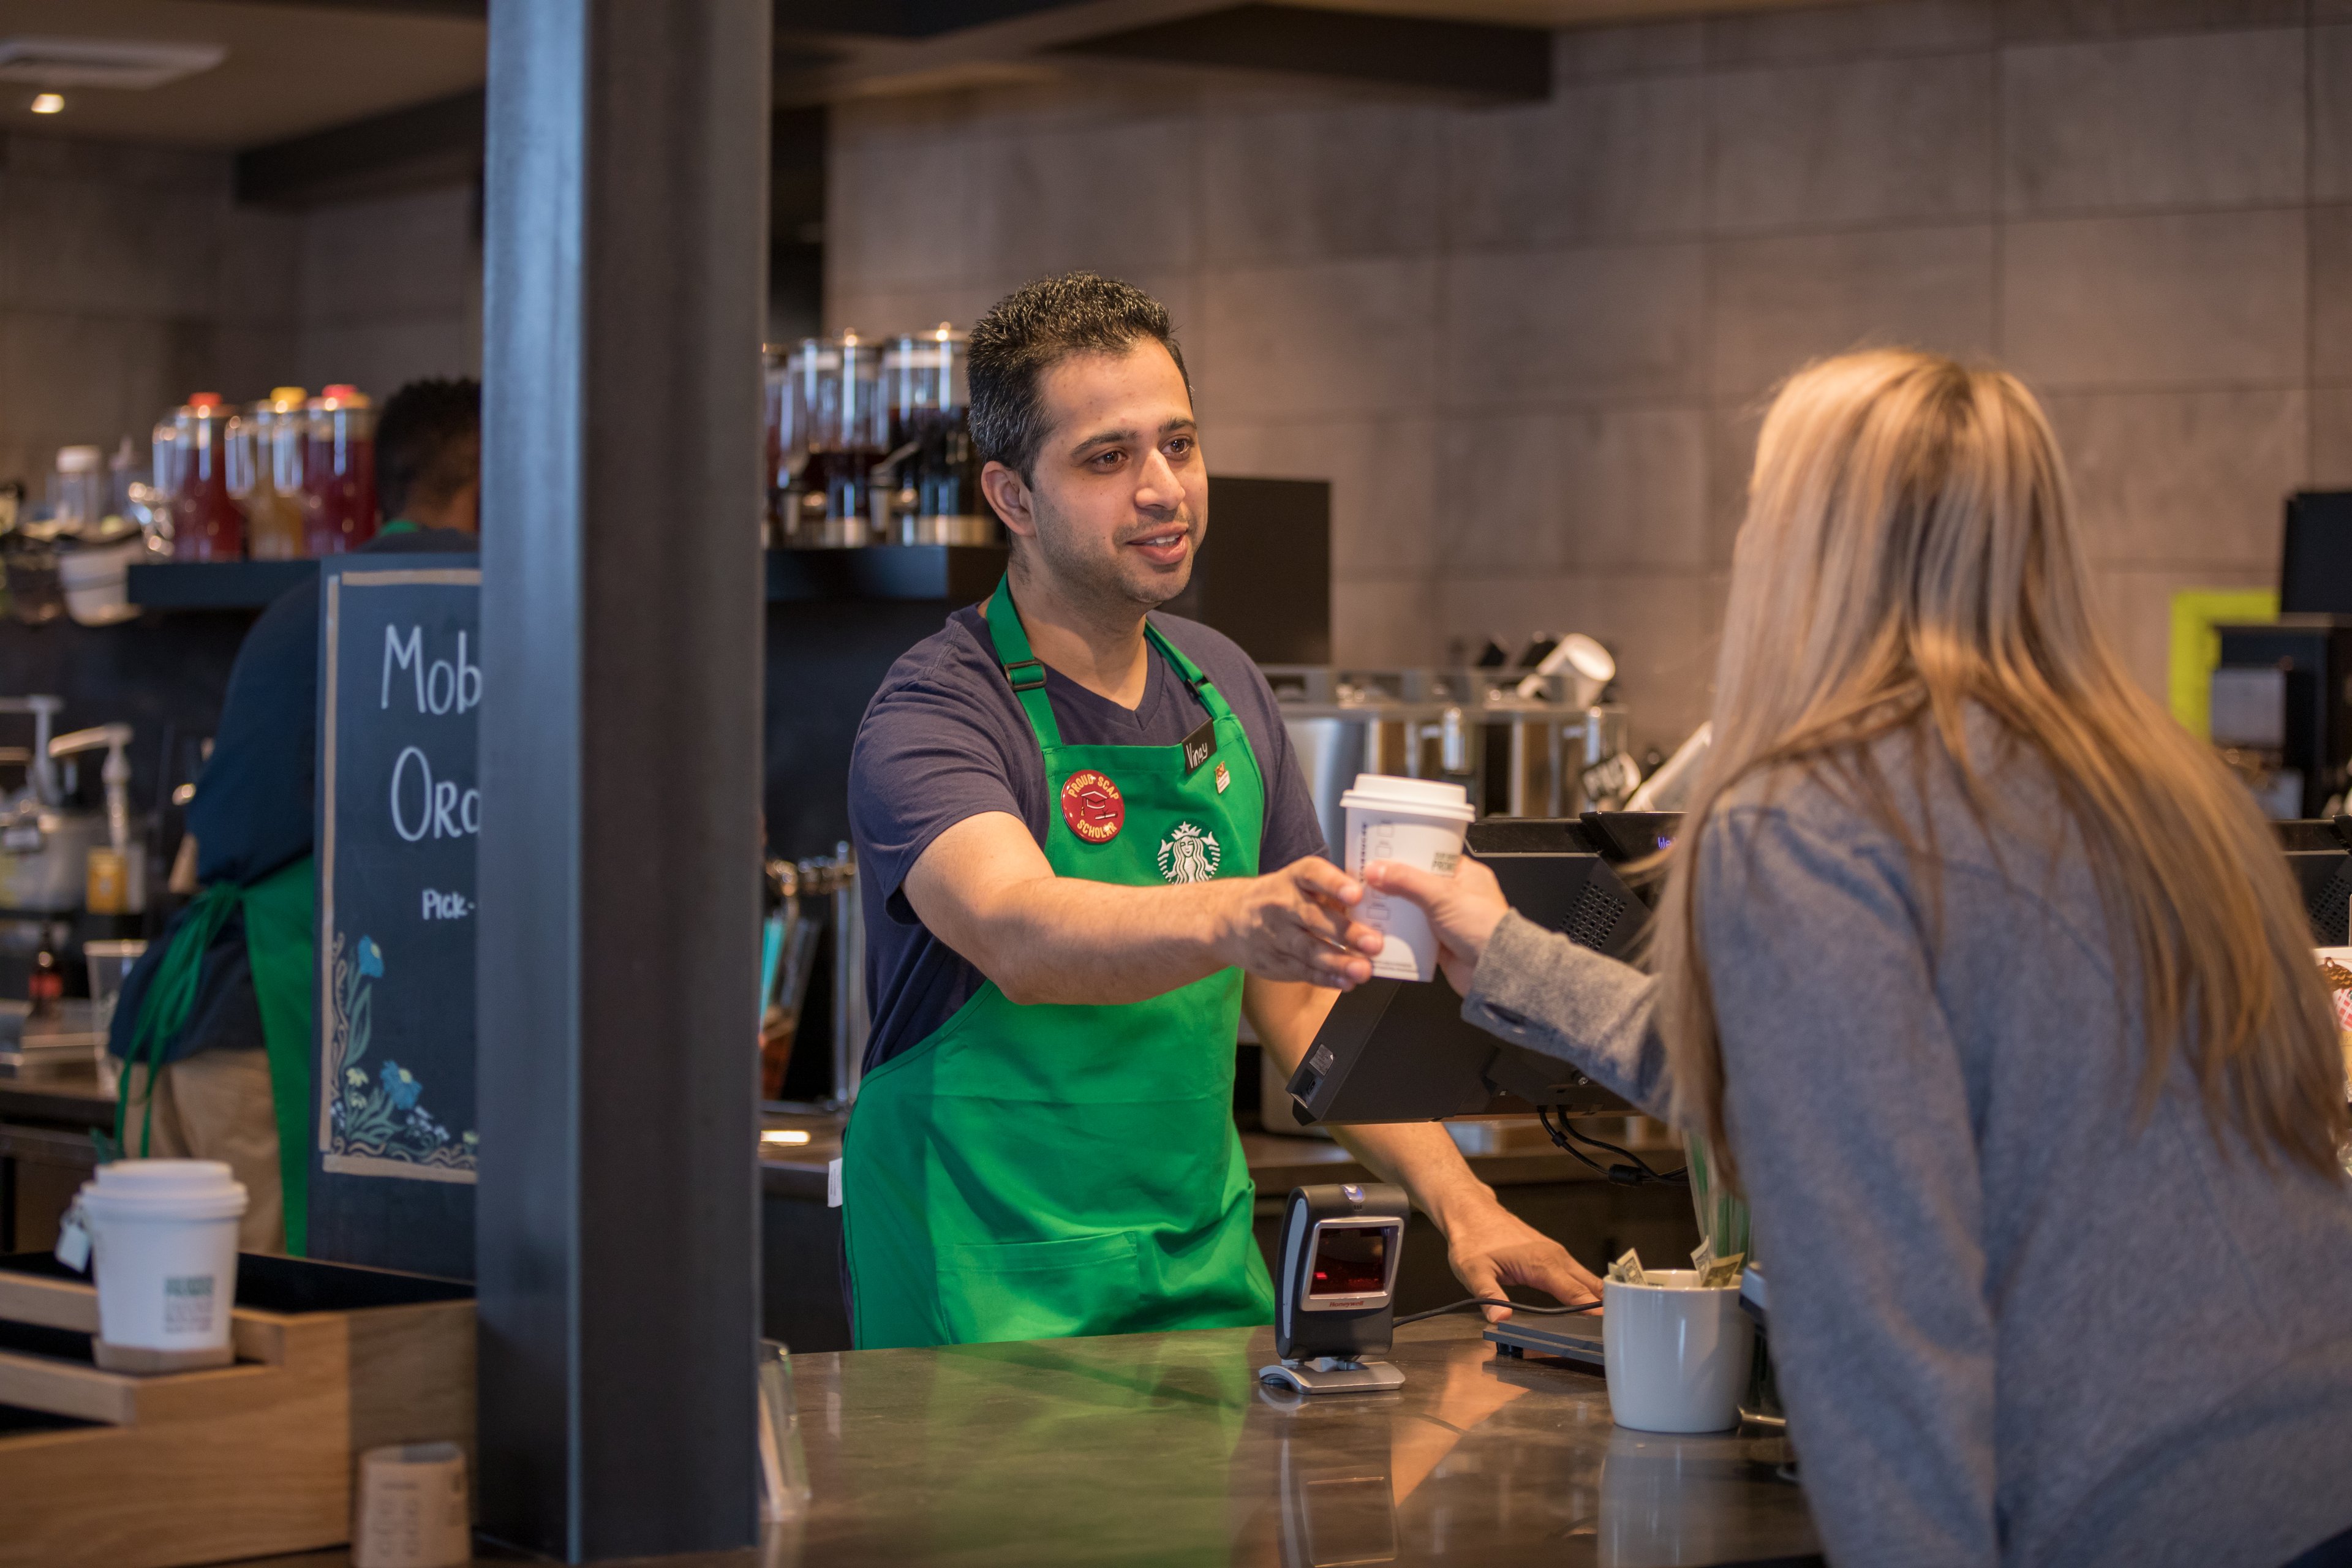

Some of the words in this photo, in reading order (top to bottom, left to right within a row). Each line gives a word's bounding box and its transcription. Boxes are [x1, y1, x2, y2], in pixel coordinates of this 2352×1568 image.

[381, 624, 482, 715] Mob
[1186, 742, 1208, 769] Vinay
[1068, 774, 1096, 798] PROUD
[1097, 776, 1119, 799] SCAP
[1077, 820, 1117, 839] SCHOLAR
[1657, 837, 1675, 850] We
